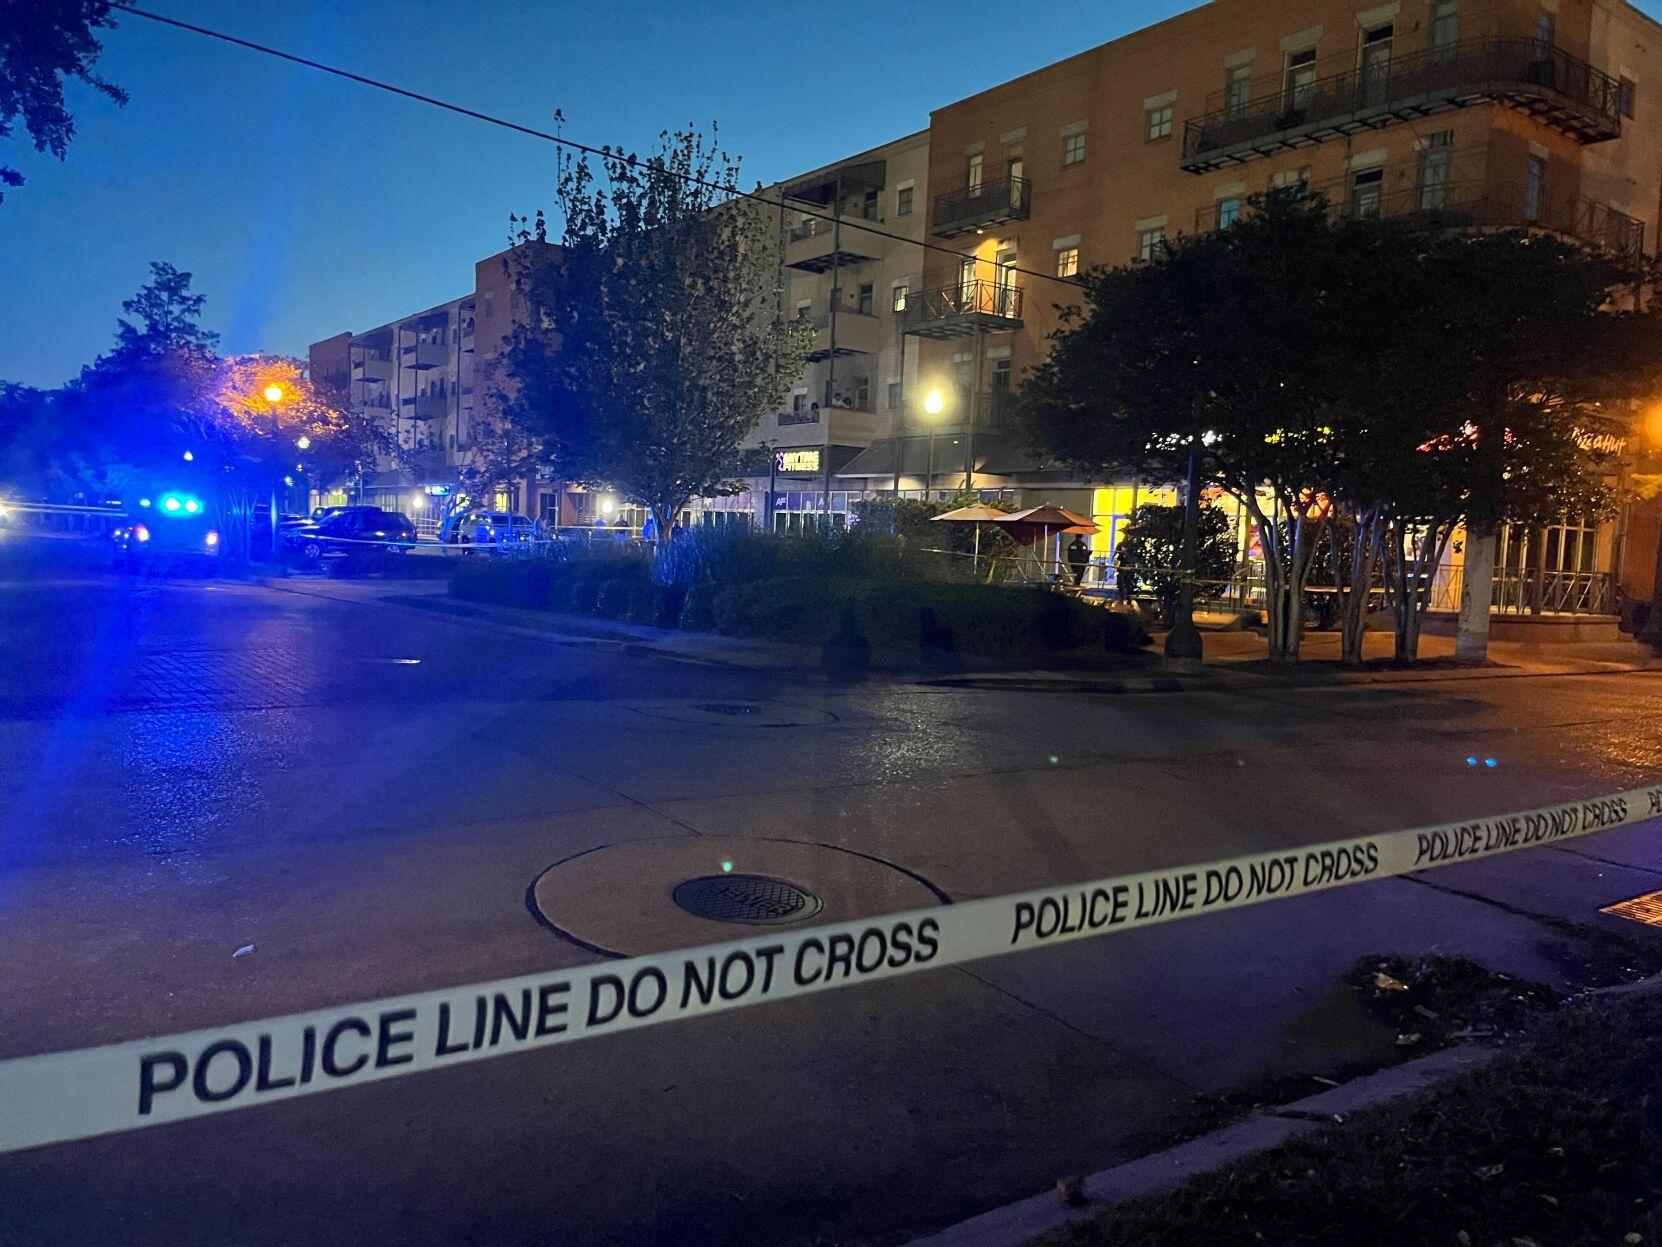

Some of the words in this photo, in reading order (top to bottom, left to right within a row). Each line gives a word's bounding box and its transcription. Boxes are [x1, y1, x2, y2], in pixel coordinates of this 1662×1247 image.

[1602, 433, 1627, 457] Hut
[1415, 825, 1482, 865] POLICE
[1485, 818, 1522, 851] LINE
[1523, 813, 1548, 843] DO
[1549, 806, 1579, 836] NOT
[1582, 797, 1627, 830] CROSS
[1011, 884, 1129, 944] POLICE
[1135, 873, 1197, 920] LINE
[1202, 865, 1243, 906] DO
[1246, 856, 1299, 899] NOT
[1303, 842, 1379, 886] CROSS
[137, 1009, 417, 1115] POLICE
[435, 981, 573, 1057] LINE
[586, 966, 668, 1026] DO
[680, 944, 786, 1009] NOT
[793, 917, 940, 985] CROSS
